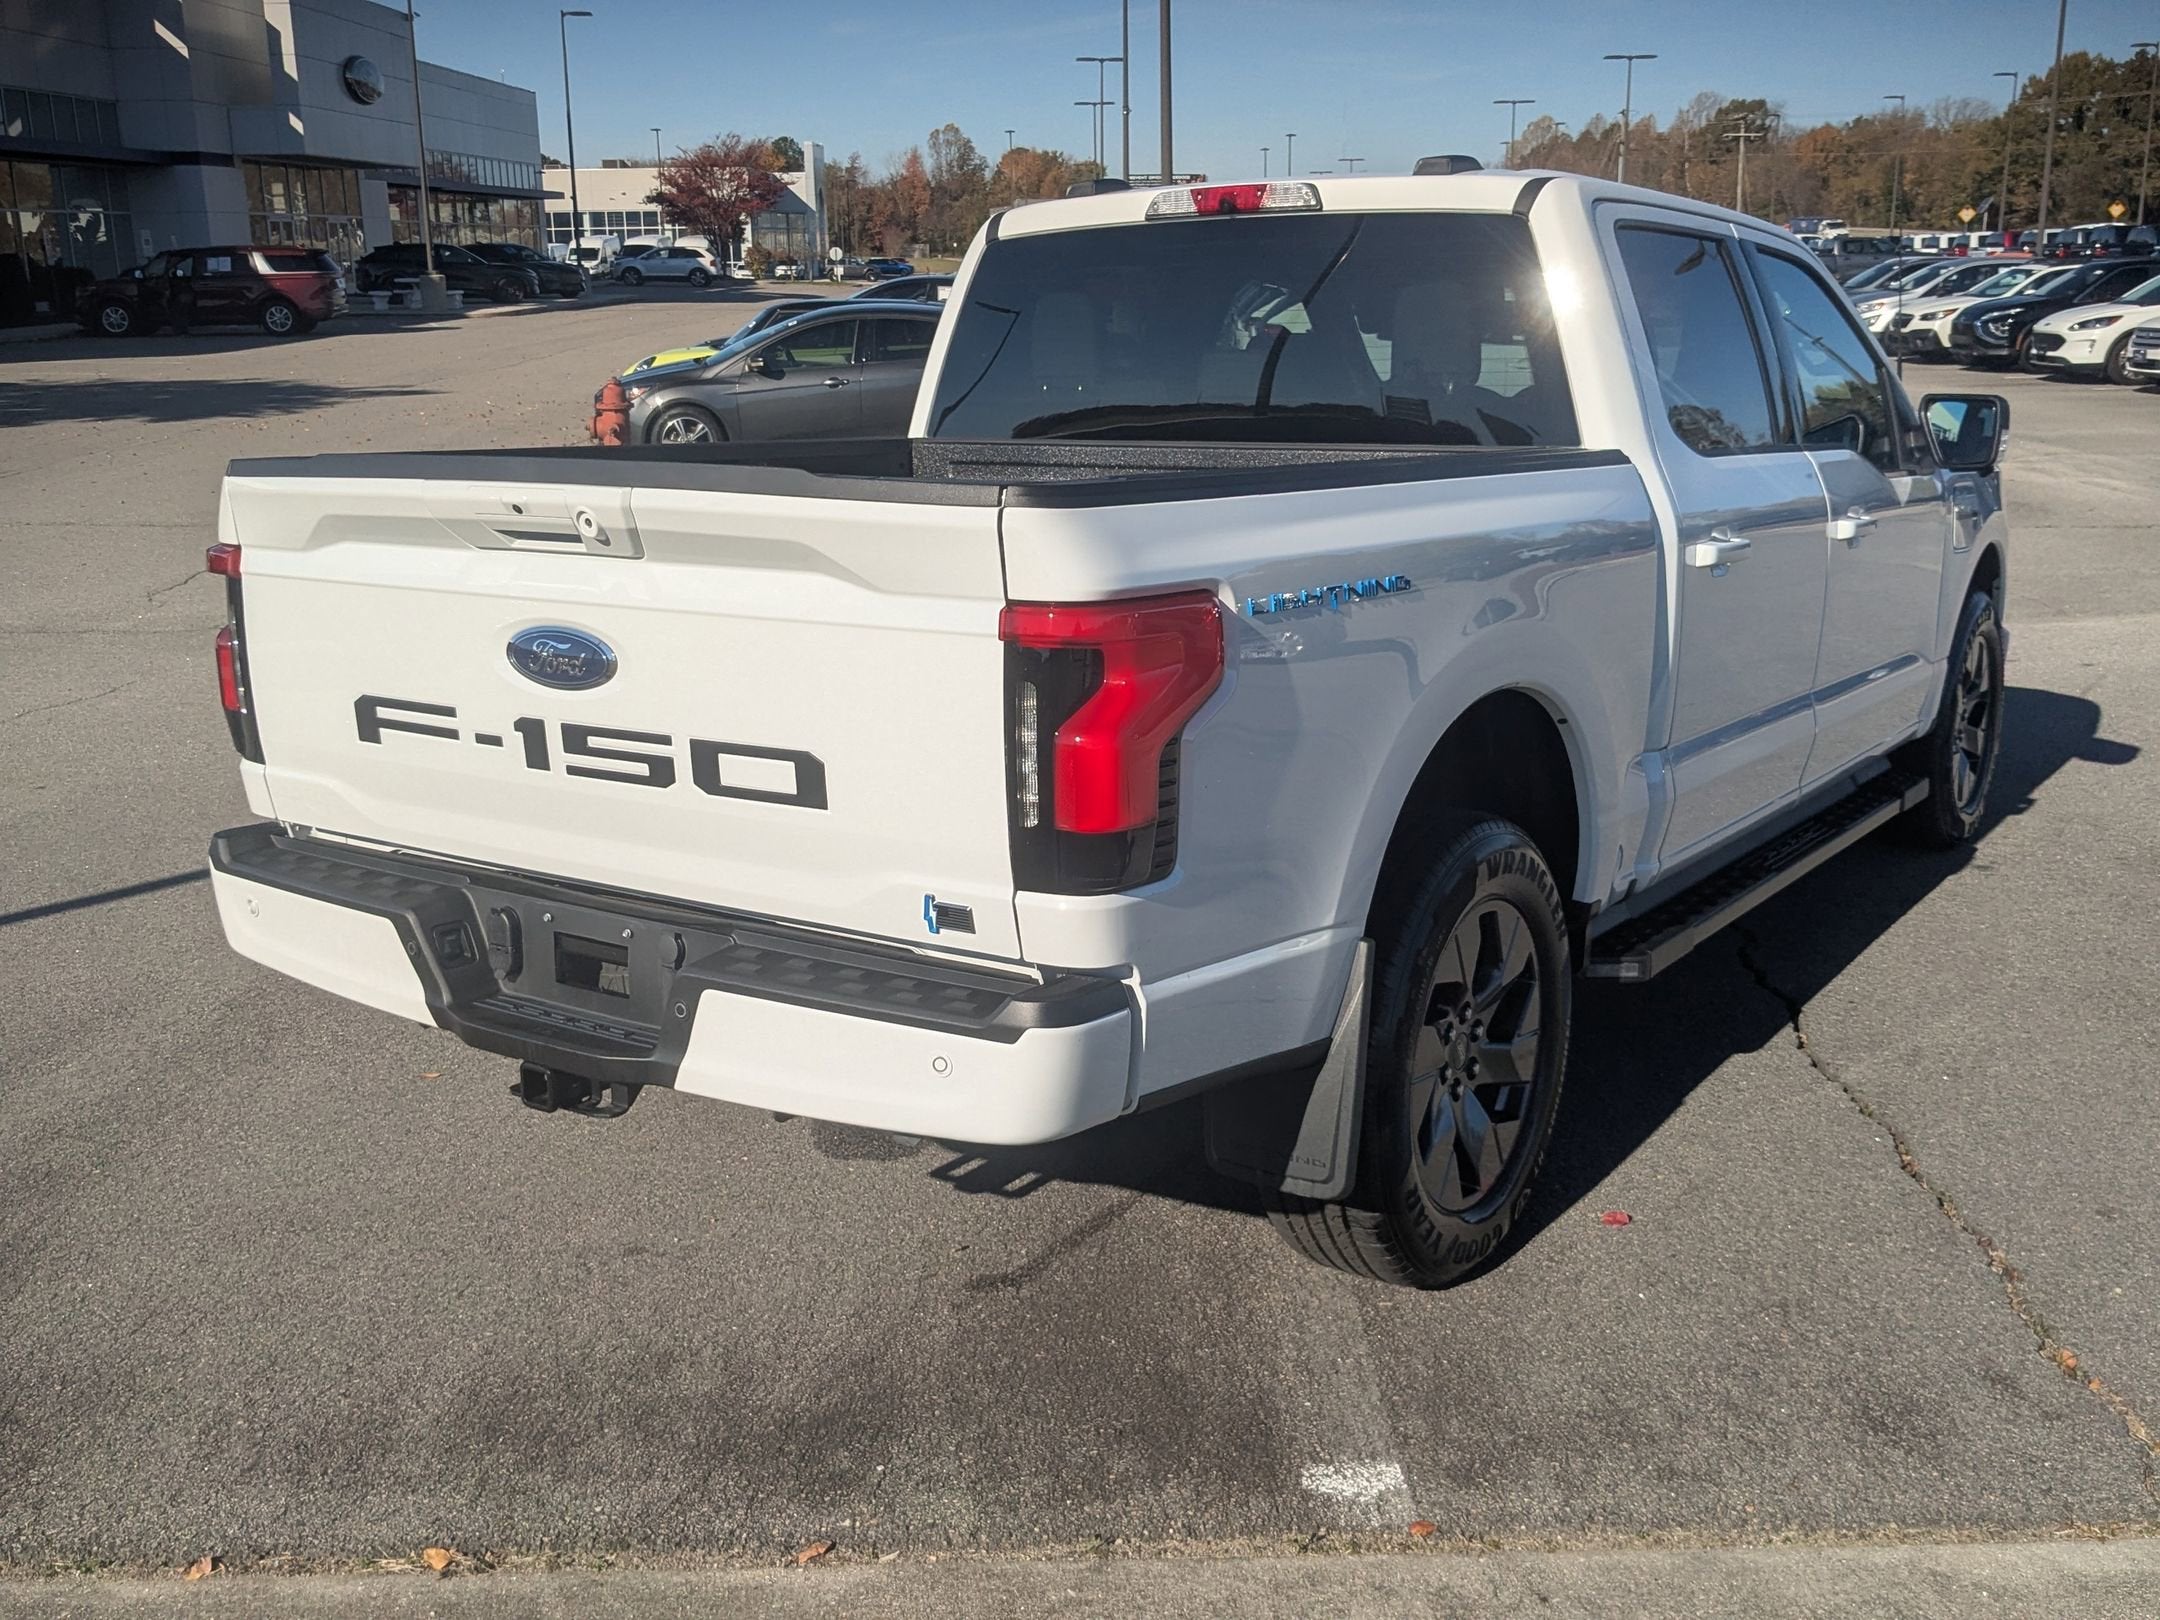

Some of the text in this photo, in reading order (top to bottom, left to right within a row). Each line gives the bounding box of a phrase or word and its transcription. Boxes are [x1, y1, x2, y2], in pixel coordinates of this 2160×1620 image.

[1247, 574, 1412, 617] LIGHTNING
[528, 638, 586, 677] Ford
[353, 694, 829, 810] F-150
[1484, 850, 1568, 942] WRANGLER
